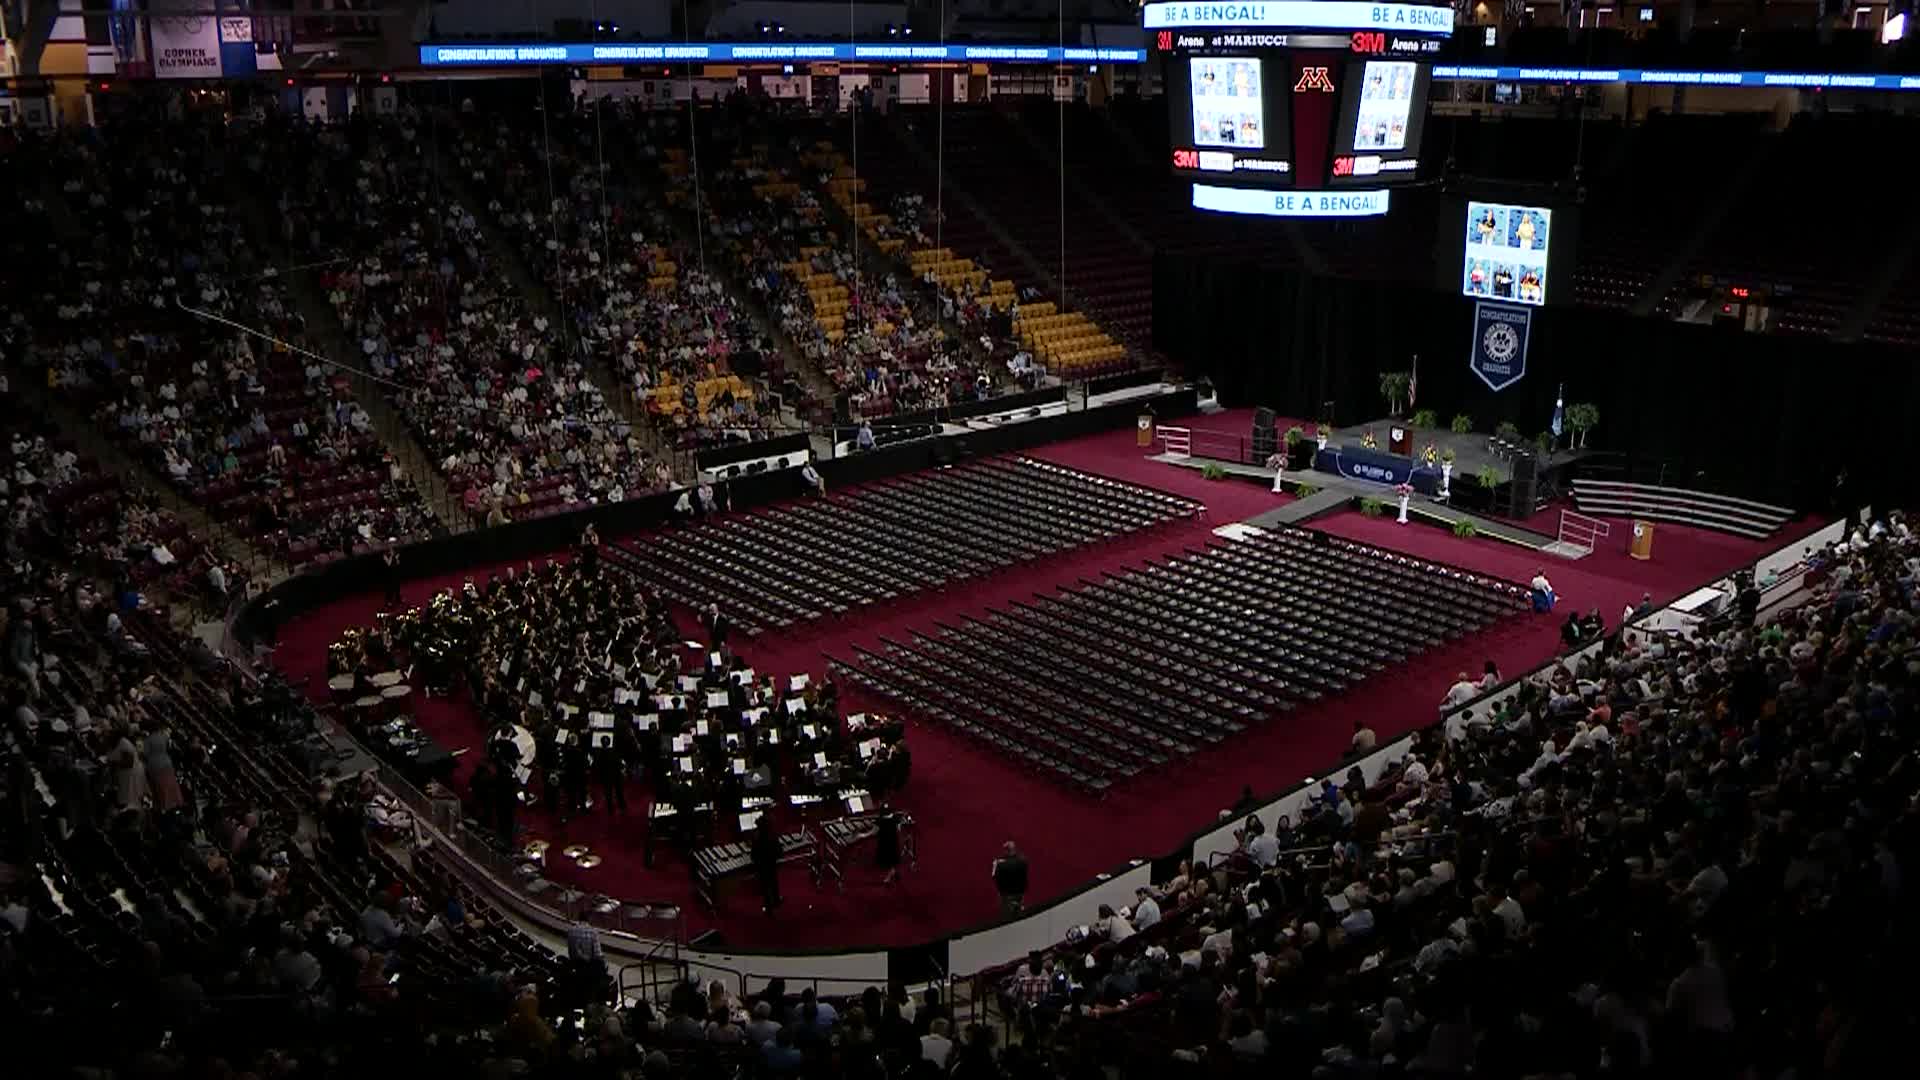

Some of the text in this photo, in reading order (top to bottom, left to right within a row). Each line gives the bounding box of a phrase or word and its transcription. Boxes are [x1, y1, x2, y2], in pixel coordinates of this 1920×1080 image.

[1165, 5, 1265, 22] BE A BENGAL!
[1372, 7, 1390, 22] BE
[1395, 8, 1404, 23] A
[1157, 31, 1288, 51] 3M Arena at MARIUCCI
[1351, 31, 1385, 53] 3M
[1391, 37, 1418, 52] Arena
[164, 48, 206, 58] GOPHER
[159, 57, 217, 67] OLYMPIANS
[1294, 67, 1335, 92] M
[1174, 151, 1198, 168] 3M
[1334, 158, 1354, 175] 3M
[1275, 196, 1294, 211] BE
[1301, 196, 1313, 211] A
